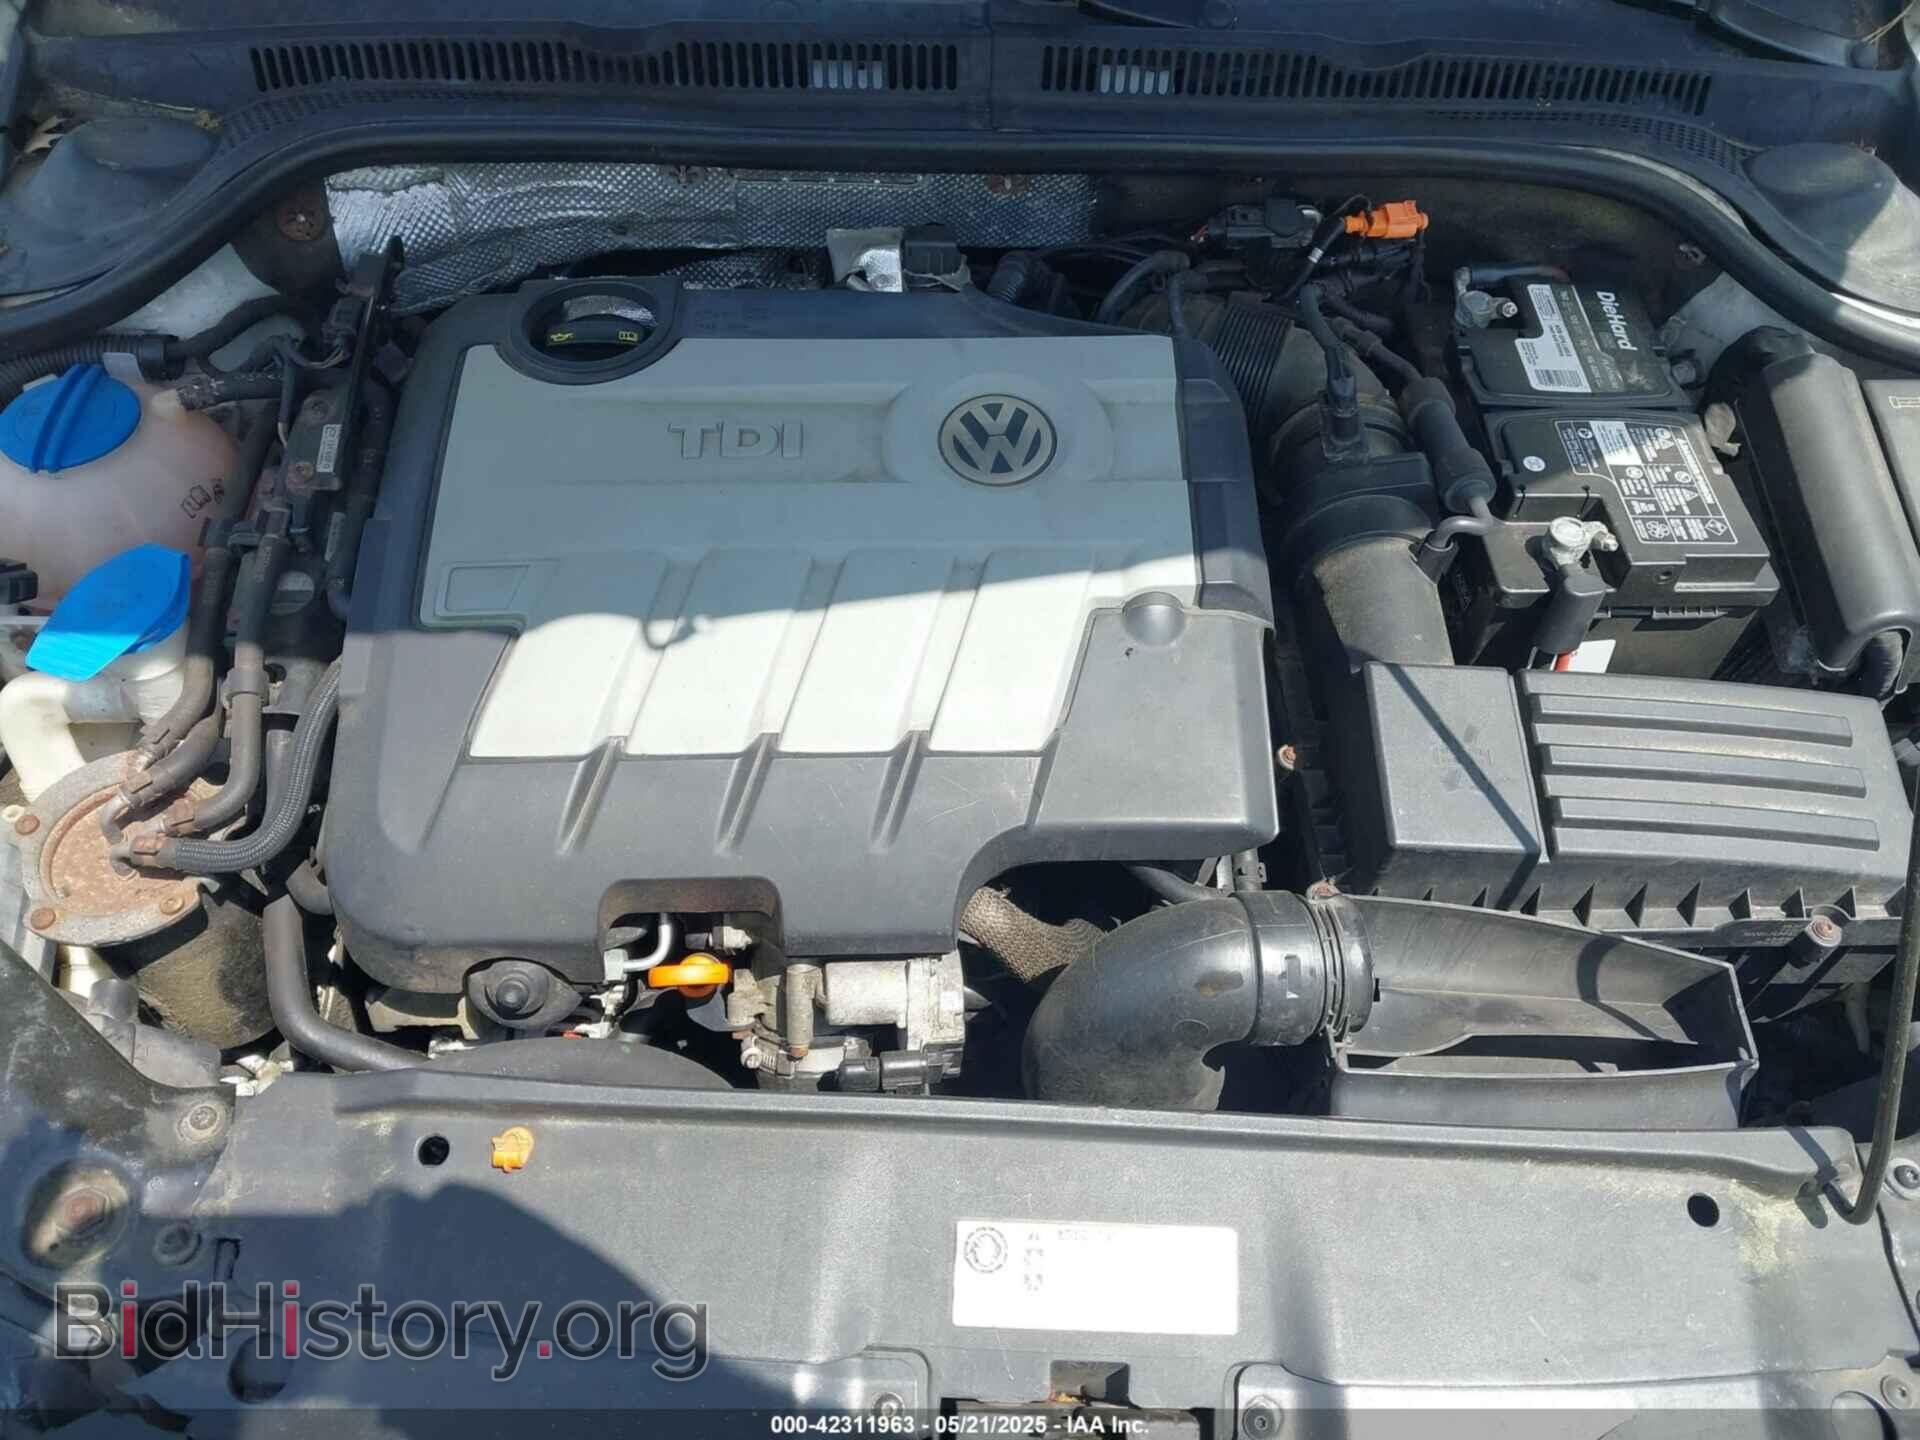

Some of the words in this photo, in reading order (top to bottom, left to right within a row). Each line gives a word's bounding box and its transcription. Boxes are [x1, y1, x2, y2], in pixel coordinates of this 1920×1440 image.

[1596, 290, 1638, 352] DieHard
[667, 420, 805, 460] TDI
[940, 395, 1056, 486] VW
